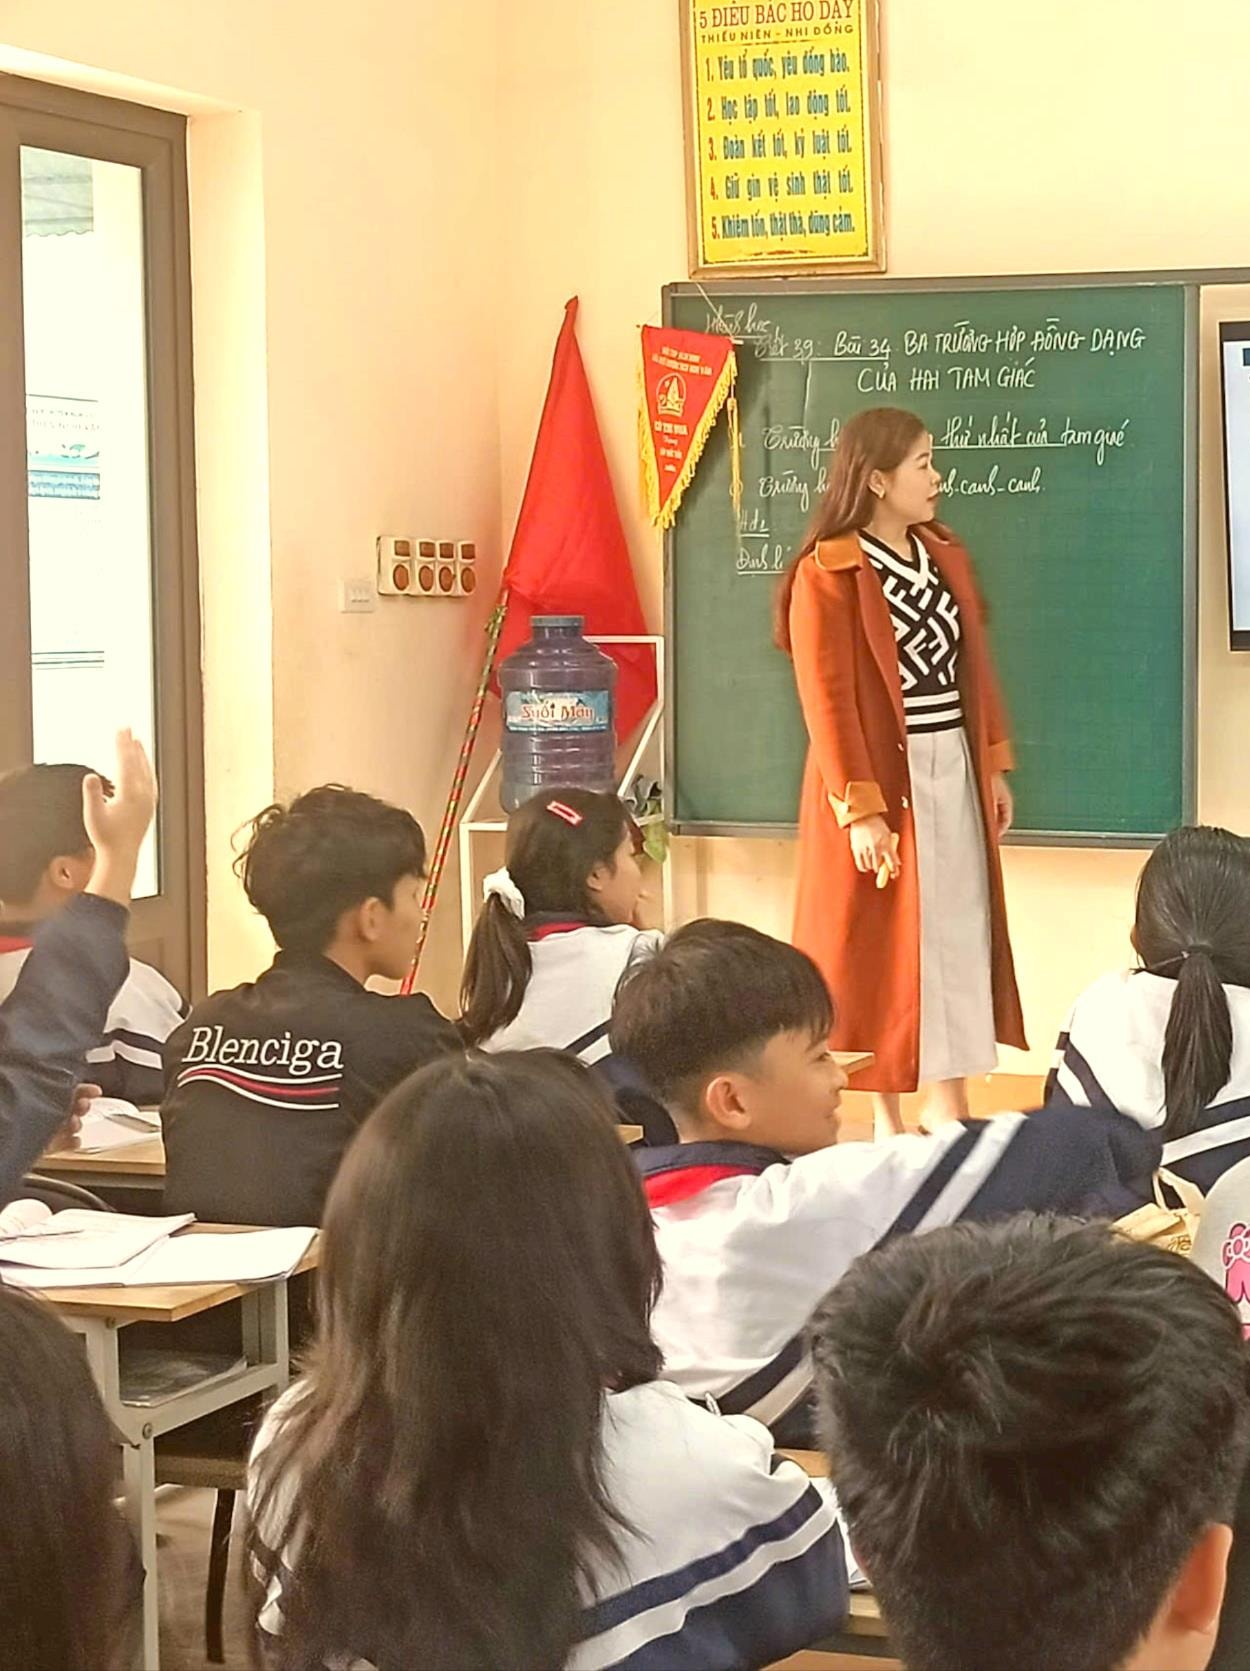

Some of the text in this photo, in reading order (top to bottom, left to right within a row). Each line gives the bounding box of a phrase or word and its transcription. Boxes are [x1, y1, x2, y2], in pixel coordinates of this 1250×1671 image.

[700, 11, 708, 28] 5
[740, 28, 772, 40] NIÊN
[785, 26, 809, 37] NHI
[786, 91, 800, 116] lao
[786, 171, 806, 196] sinh
[904, 330, 929, 355] BA
[1090, 326, 1147, 357] DẠNG
[857, 356, 1036, 392] CỦA HAI TAM GIÁC
[181, 1025, 345, 1076] Blenciga
